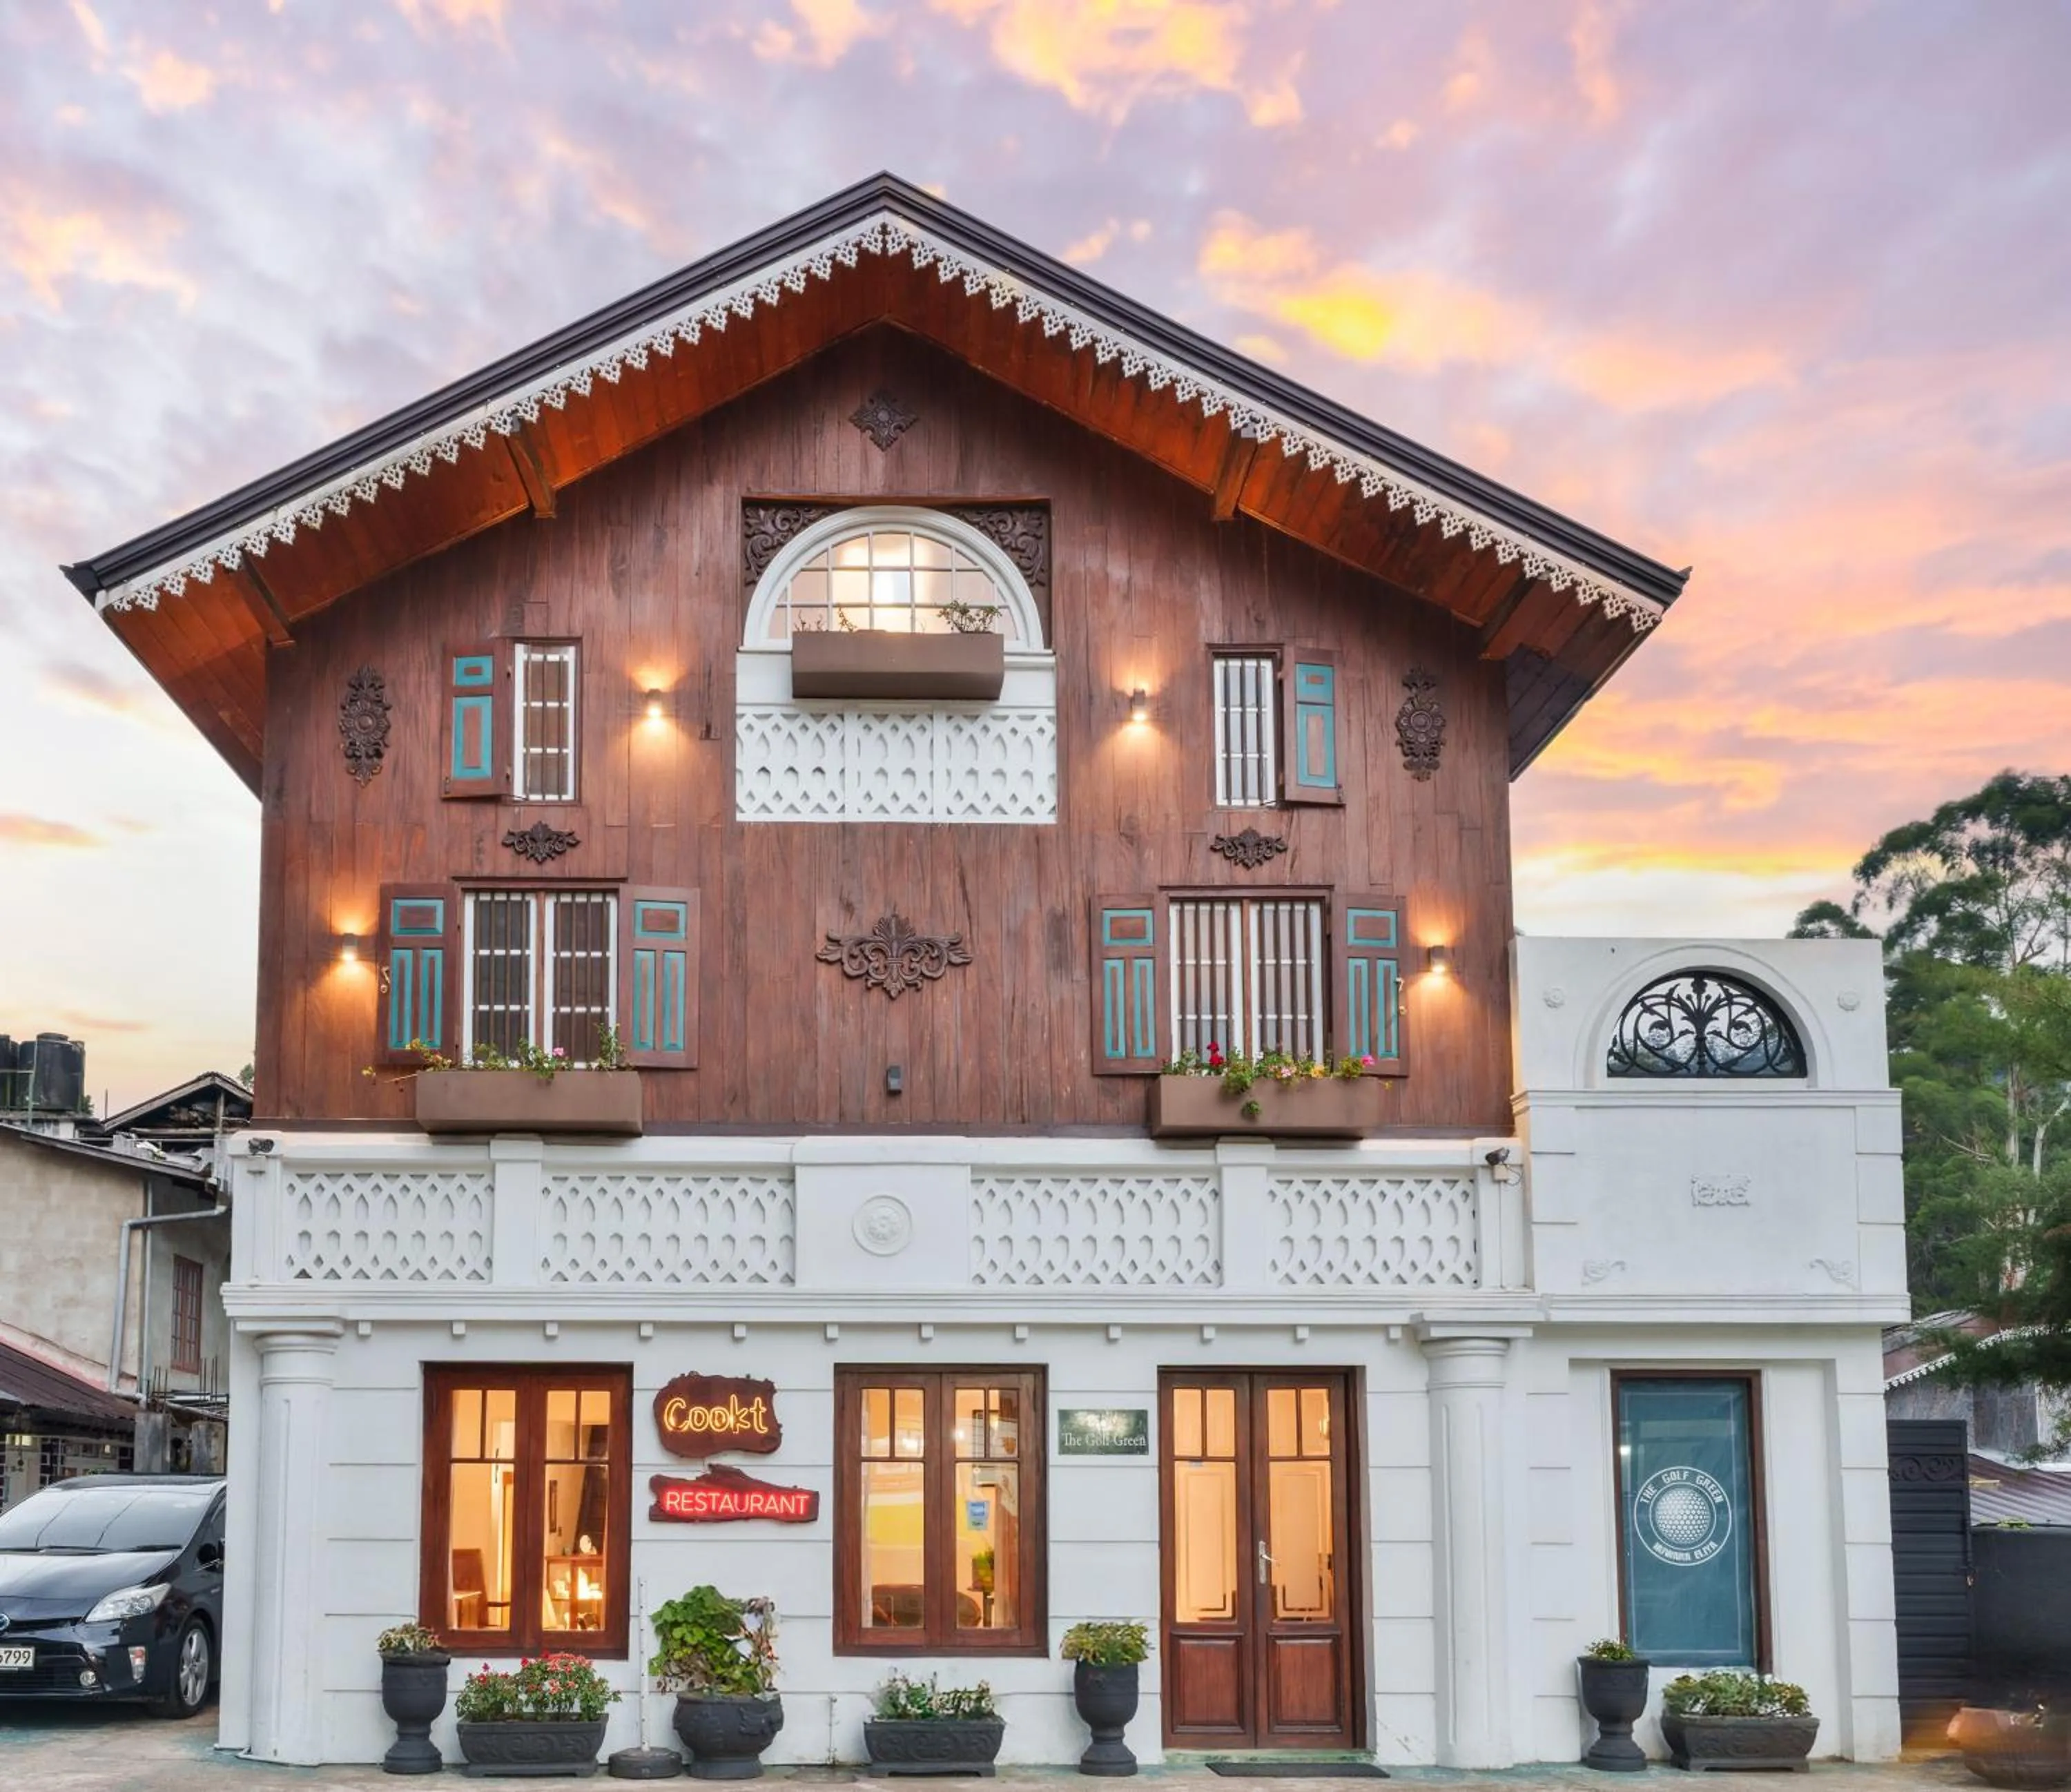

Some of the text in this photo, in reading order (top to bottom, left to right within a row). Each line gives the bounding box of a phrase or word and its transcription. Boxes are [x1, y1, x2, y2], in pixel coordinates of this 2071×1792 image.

[664, 1393, 769, 1434] Cookt
[1062, 1432, 1082, 1447] The
[1114, 1435, 1147, 1447] Green
[1640, 1470, 1724, 1503] THE GOLF GREEN
[665, 1490, 810, 1515] RESTAURANT
